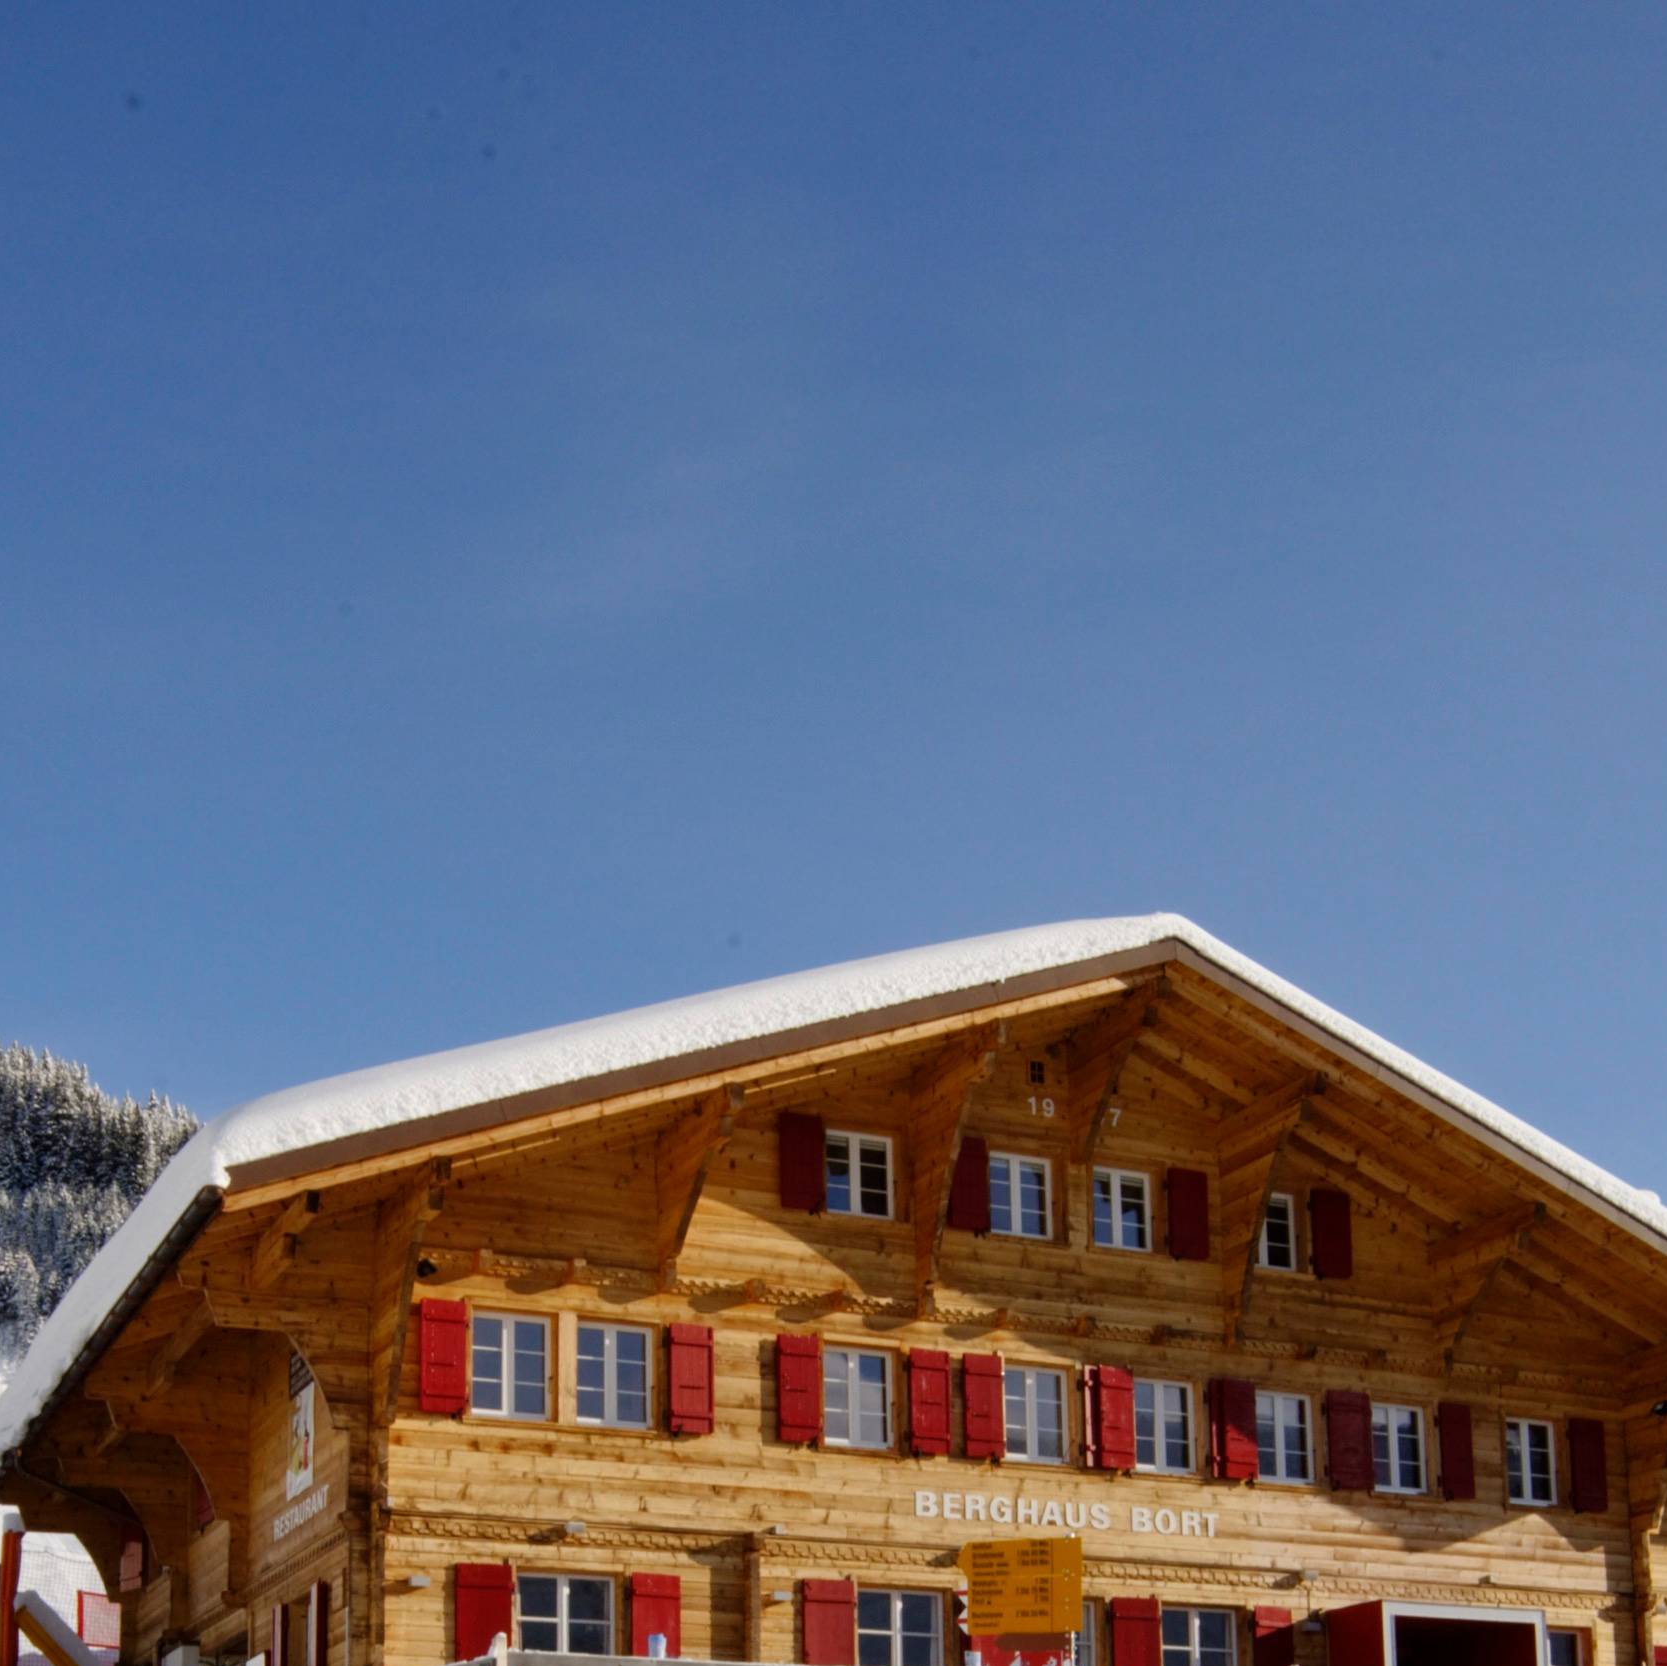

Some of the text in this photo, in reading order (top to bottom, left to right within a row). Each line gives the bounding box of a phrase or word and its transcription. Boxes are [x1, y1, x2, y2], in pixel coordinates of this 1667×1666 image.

[1027, 1096, 1055, 1118] 19
[273, 1484, 329, 1542] RESTAURANT
[914, 1490, 1220, 1538] BERGHAUS BORT
